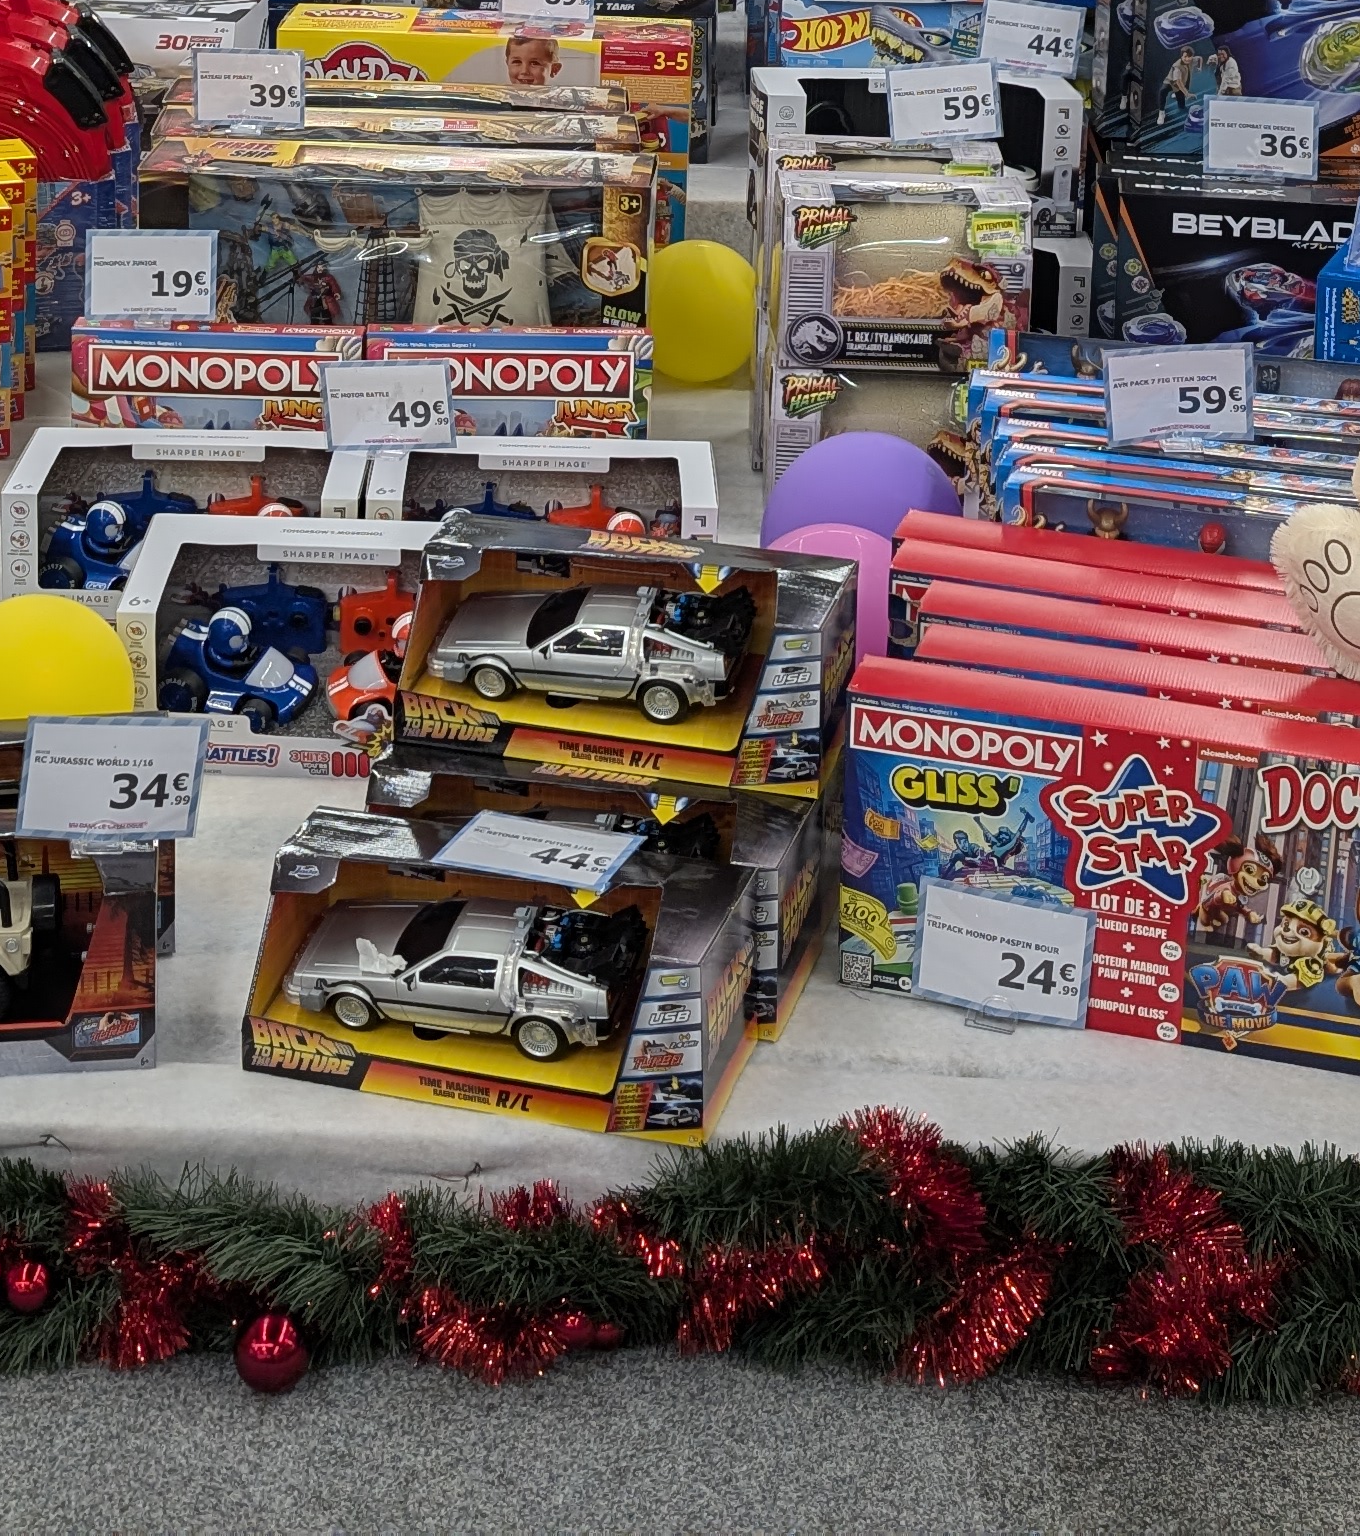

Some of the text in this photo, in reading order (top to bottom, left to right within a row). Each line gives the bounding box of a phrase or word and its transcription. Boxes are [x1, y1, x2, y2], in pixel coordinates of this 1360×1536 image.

[603, 1, 635, 12] TANK
[653, 51, 689, 71] 3-5
[797, 207, 857, 225] PRIMAL
[976, 220, 1013, 232] ATTENTION
[802, 221, 850, 241] HATCH
[556, 400, 636, 422] JUNIOR
[1020, 466, 1065, 478] MARVEL
[282, 550, 376, 561] SHARPER IMAGE
[858, 712, 1076, 774] MONOPOLY
[34, 754, 154, 767] RC JURASSIC WORLD 1/16
[290, 752, 330, 762] 3 HITS
[1057, 788, 1190, 832] SUPER
[1085, 836, 1194, 873] STAR
[1090, 893, 1161, 919] LOT DE 3
[926, 918, 1060, 955] TRIPACK MONOP P4SPIN BOUR
[1098, 968, 1158, 987] PAW PATROL
[647, 1006, 691, 1025] USB
[268, 1050, 355, 1076] FUTURE
[418, 1076, 534, 1113] TIME MACHINE R/C
